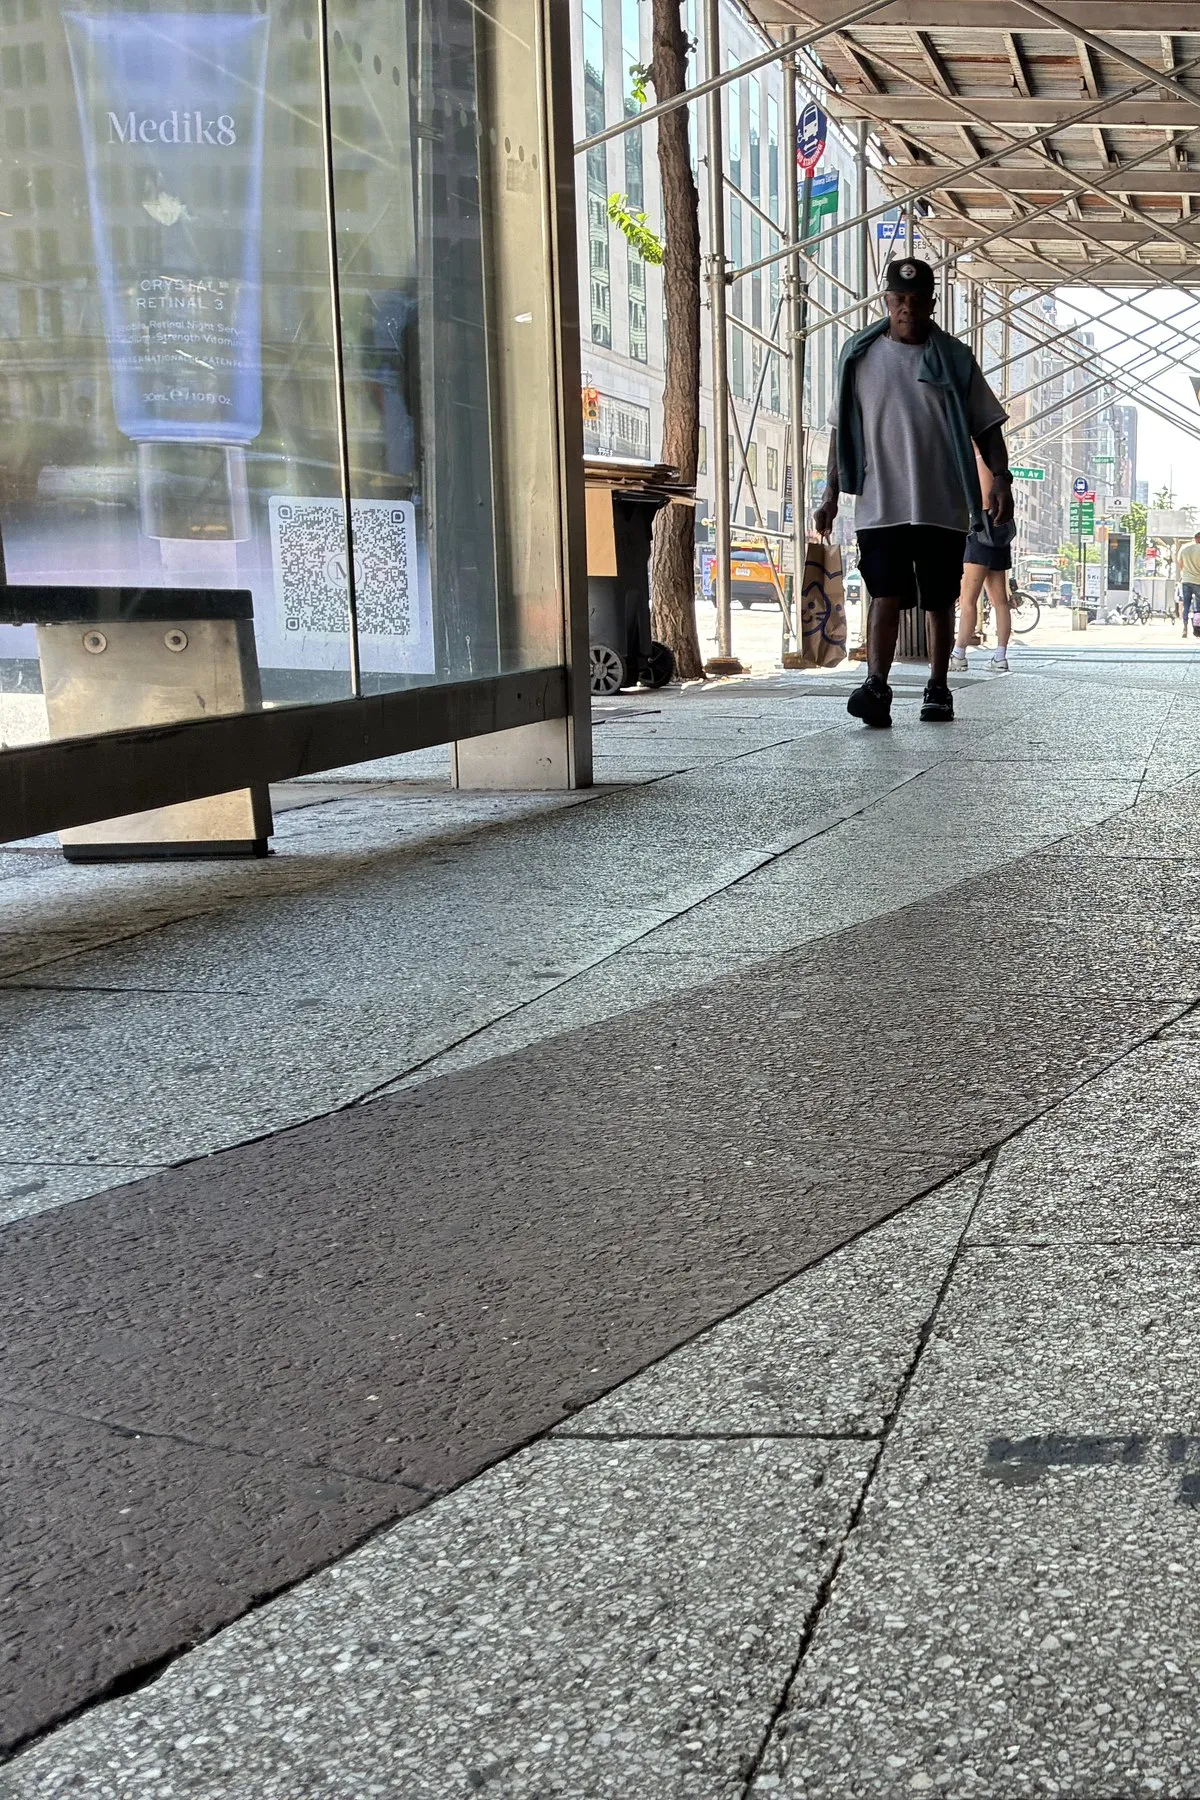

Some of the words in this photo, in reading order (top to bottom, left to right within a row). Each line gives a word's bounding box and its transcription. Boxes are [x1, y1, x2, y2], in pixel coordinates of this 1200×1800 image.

[106, 110, 237, 146] Medik8
[136, 297, 210, 310] RETINAL
[214, 299, 224, 310] 3
[150, 320, 185, 329] Retinal
[187, 320, 214, 331] Night
